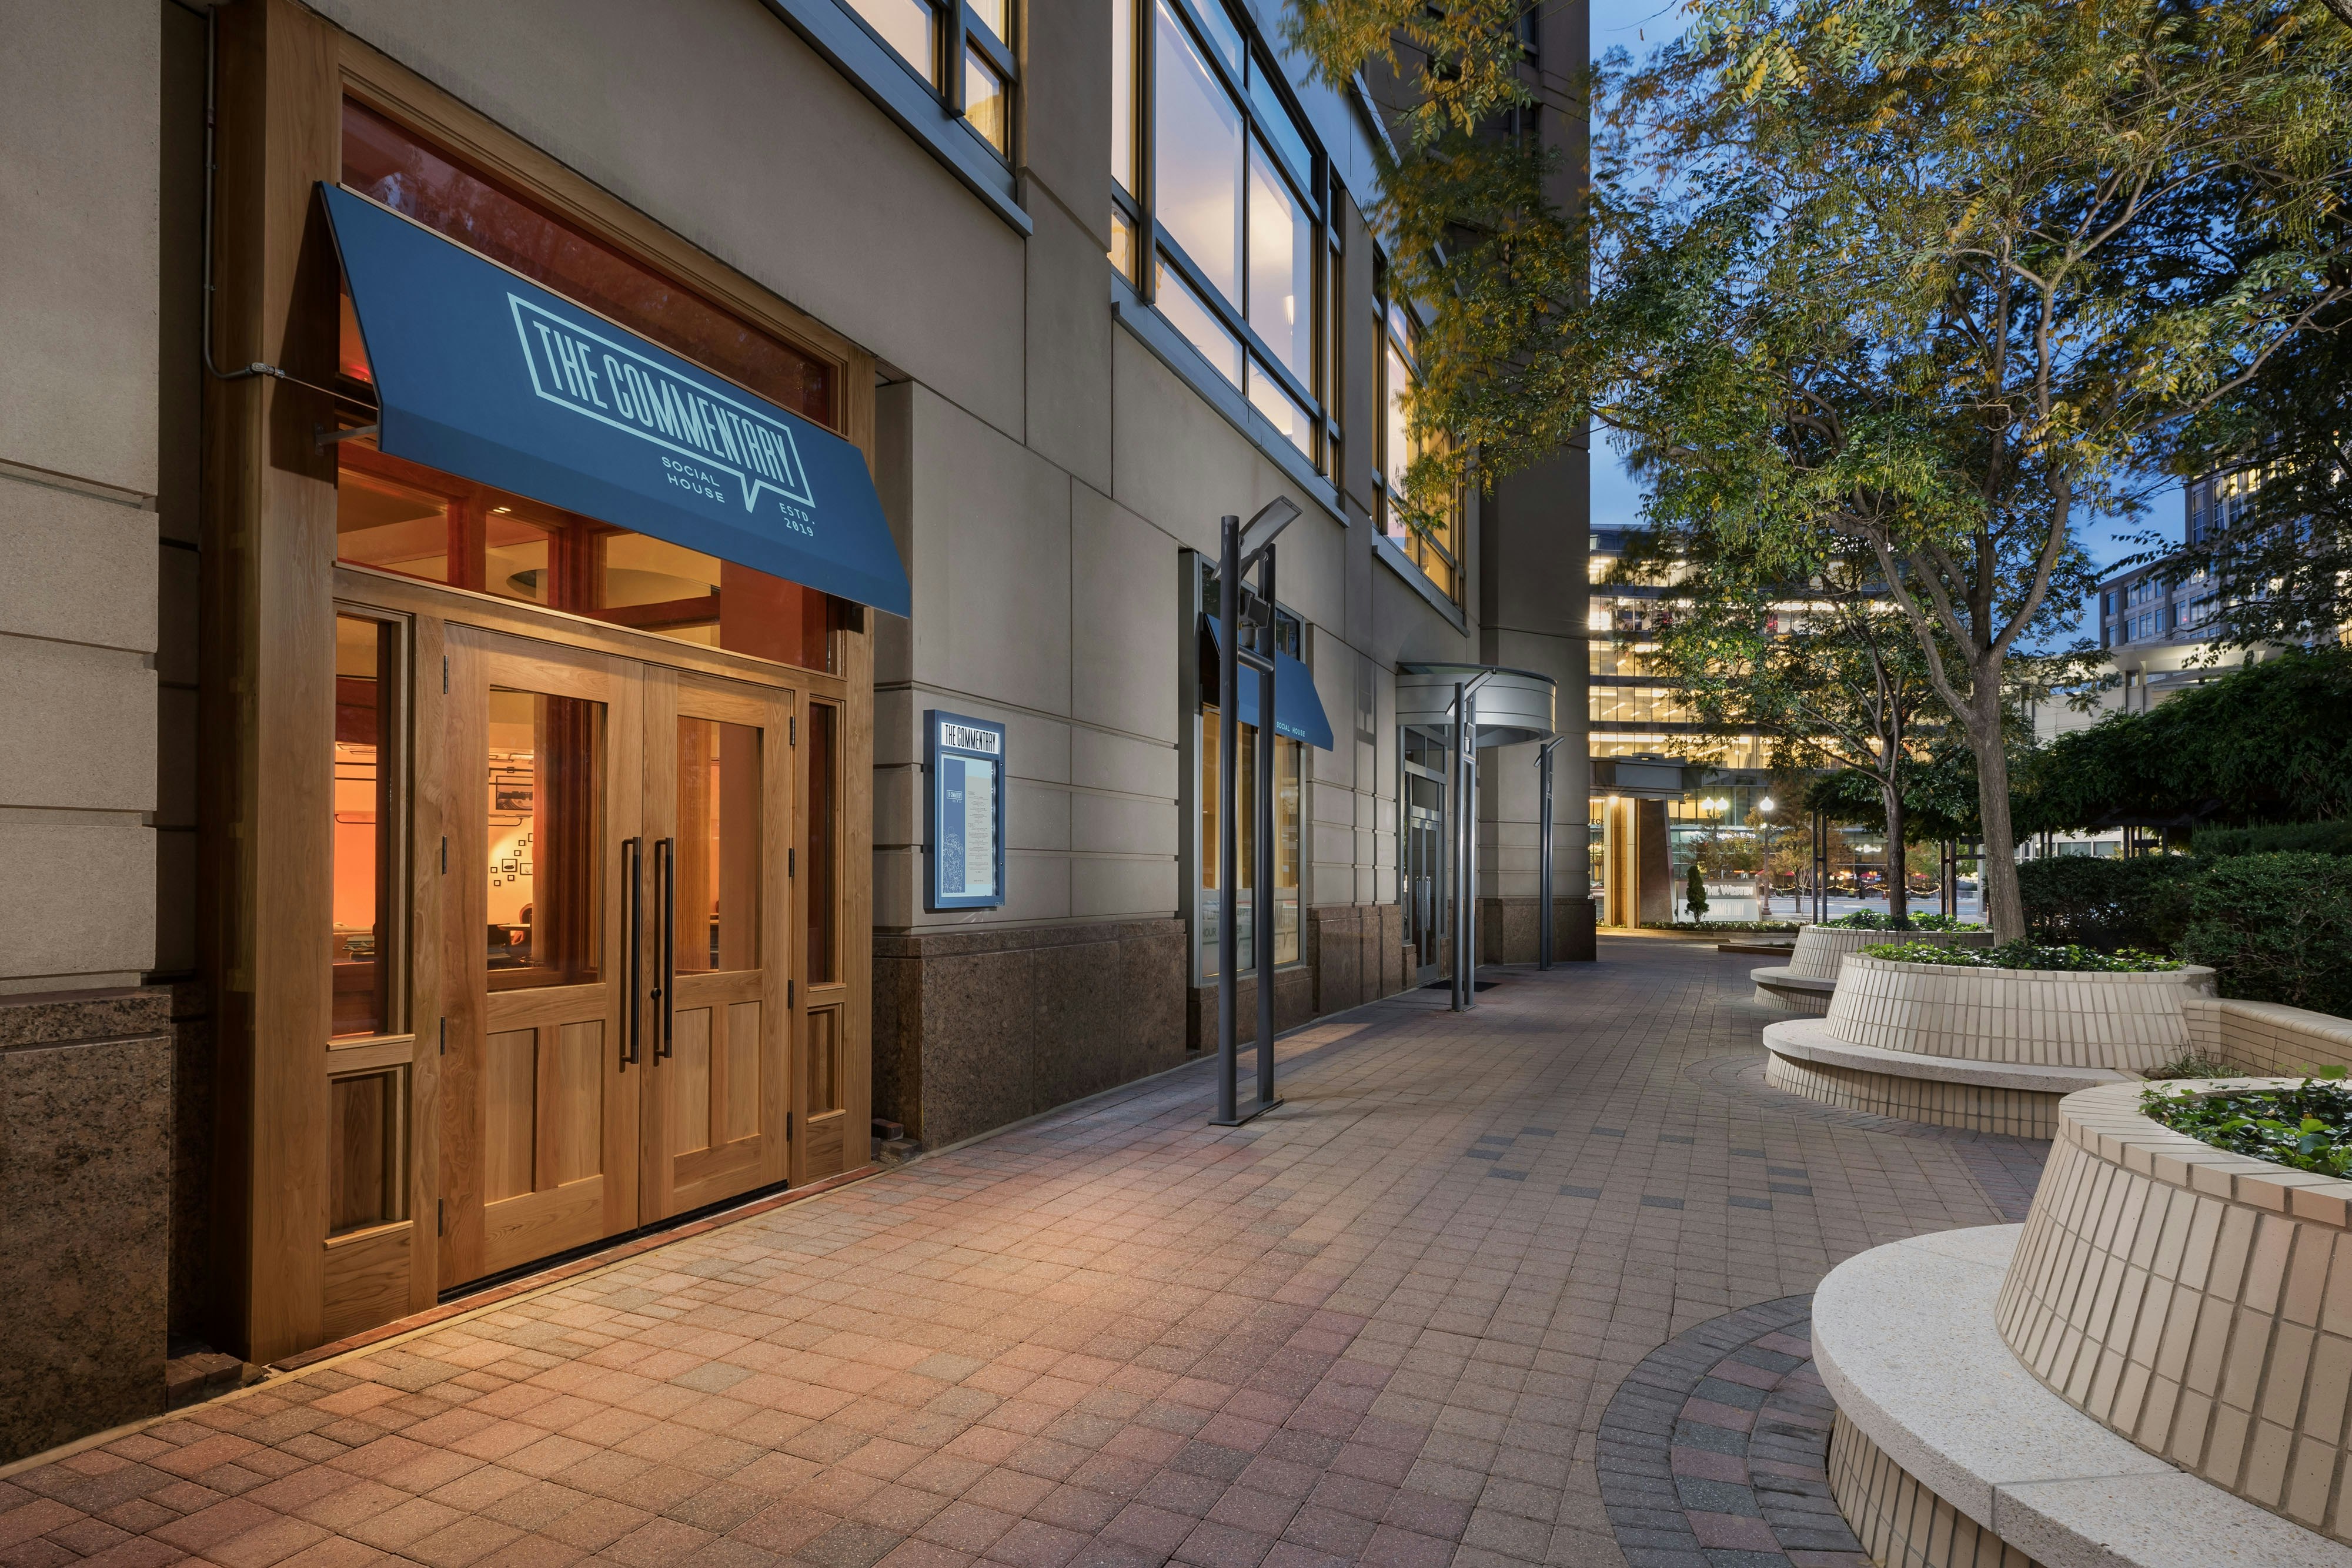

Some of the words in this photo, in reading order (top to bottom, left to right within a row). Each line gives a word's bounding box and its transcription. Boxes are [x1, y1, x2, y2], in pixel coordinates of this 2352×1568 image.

[533, 321, 608, 409] THE
[603, 354, 795, 487] COMMENTARY
[662, 456, 720, 487] SOCIAL
[667, 473, 725, 503] HOUSE
[779, 502, 815, 525] ESTD.
[784, 517, 813, 537] 2019
[945, 724, 956, 745] THE
[957, 727, 995, 753] COMMENTARY
[1276, 721, 1290, 732] SOCIAL
[1292, 727, 1305, 737] HOUSE
[1720, 884, 1753, 896] WESTIN
